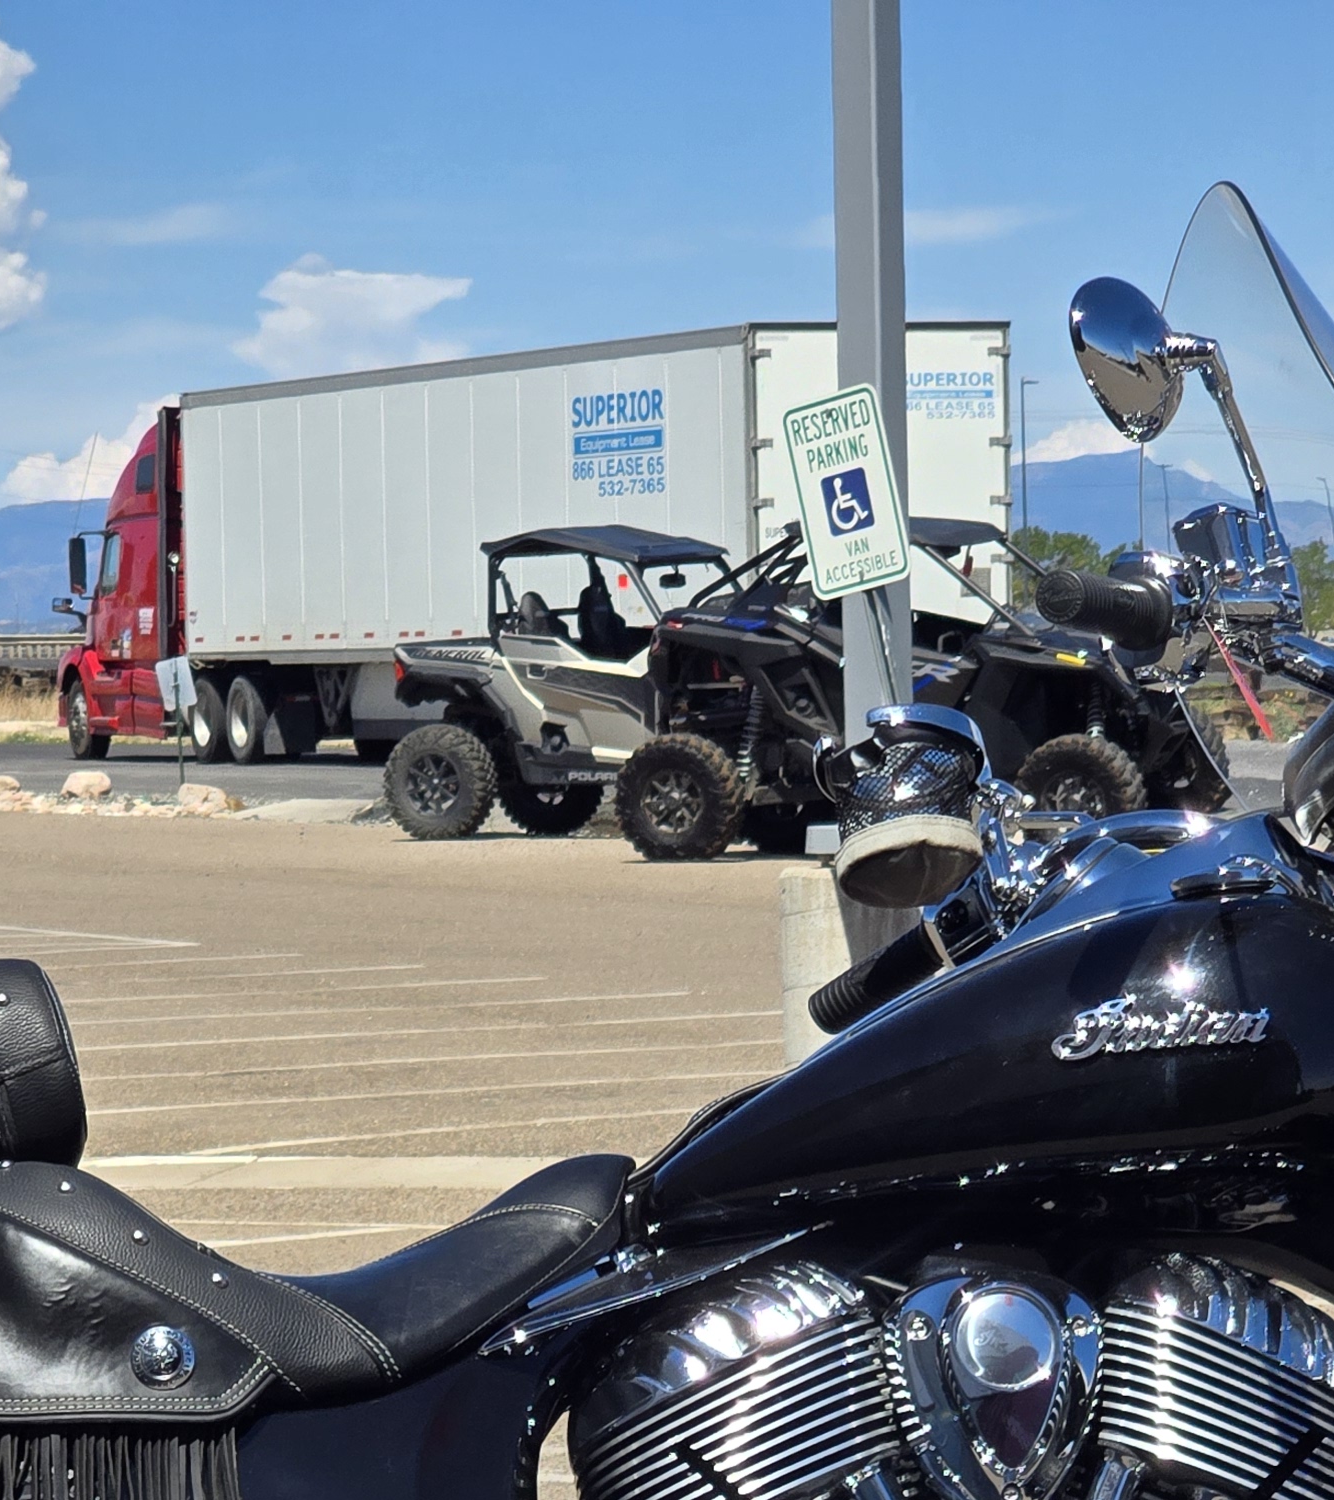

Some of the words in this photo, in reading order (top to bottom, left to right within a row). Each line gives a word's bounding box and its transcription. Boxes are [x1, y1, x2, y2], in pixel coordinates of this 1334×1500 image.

[572, 389, 664, 428] SUPERIOR
[926, 402, 974, 411] LEASE
[978, 402, 995, 411] 65
[791, 399, 870, 446] RESERVED
[807, 434, 868, 473] PARKING
[572, 461, 595, 481] 866
[598, 456, 645, 478] LEASE
[647, 456, 665, 476] 65
[598, 477, 665, 497] 532-7365
[845, 537, 870, 557] VAN
[826, 550, 898, 584] ACCESSIBLE
[568, 771, 618, 781] POLARI
[1051, 992, 1270, 1061] Indian
